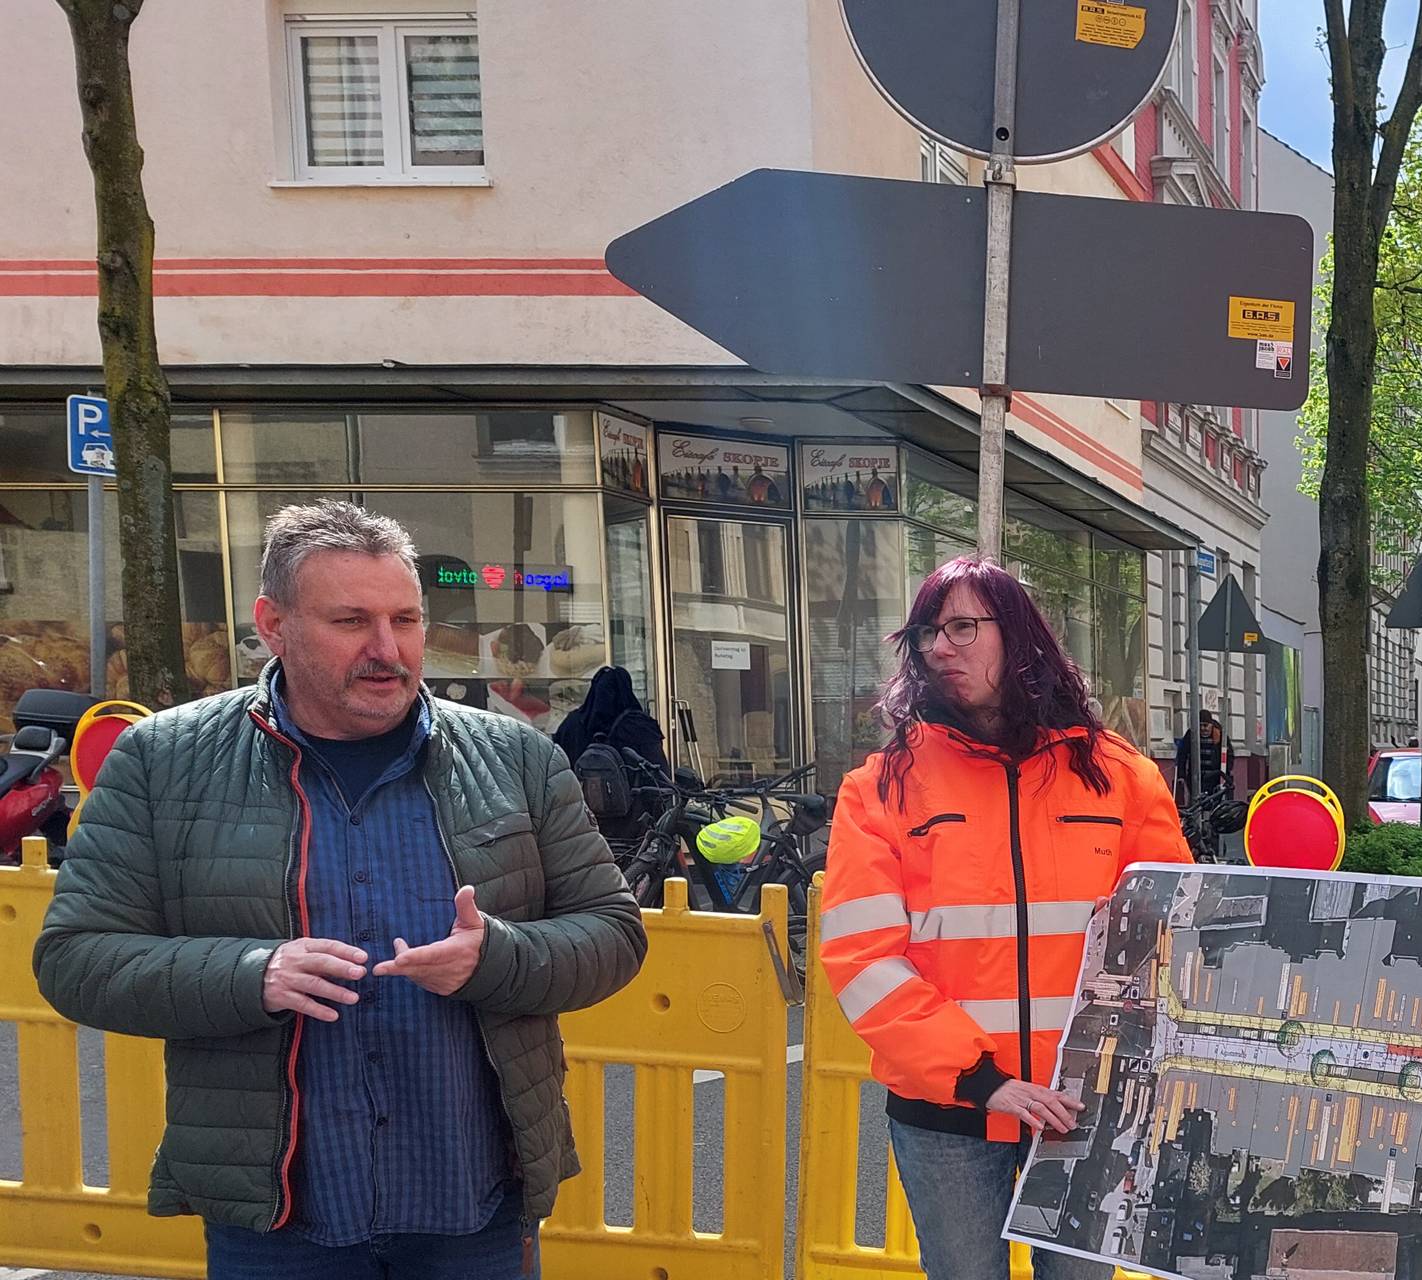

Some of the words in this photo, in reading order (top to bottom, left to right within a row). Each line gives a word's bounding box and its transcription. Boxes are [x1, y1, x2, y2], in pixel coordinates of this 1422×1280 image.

[78, 403, 103, 435] P
[723, 451, 780, 468] SKOPJE
[848, 456, 891, 469] SKOPJE
